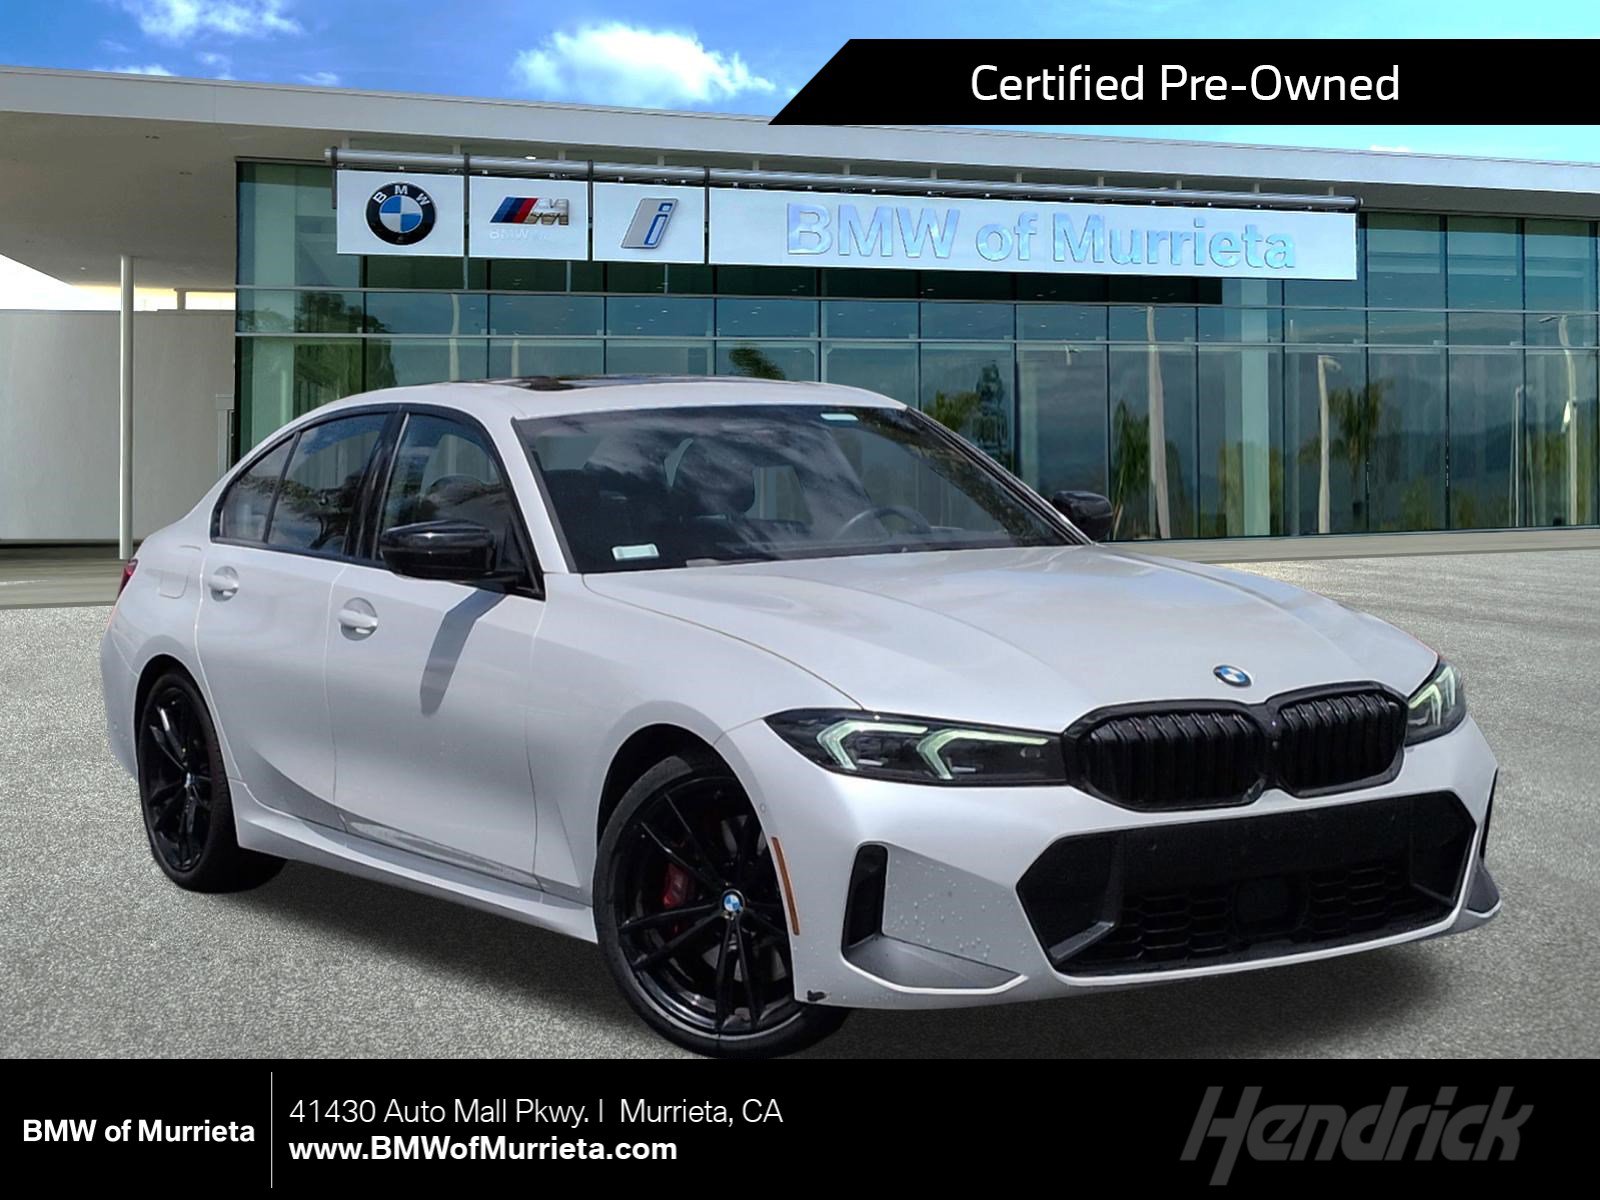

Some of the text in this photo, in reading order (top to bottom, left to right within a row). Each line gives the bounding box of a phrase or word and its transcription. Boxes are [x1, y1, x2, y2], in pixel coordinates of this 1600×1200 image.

[373, 185, 430, 205] BMW
[786, 202, 1297, 270] BMW of Murrieta
